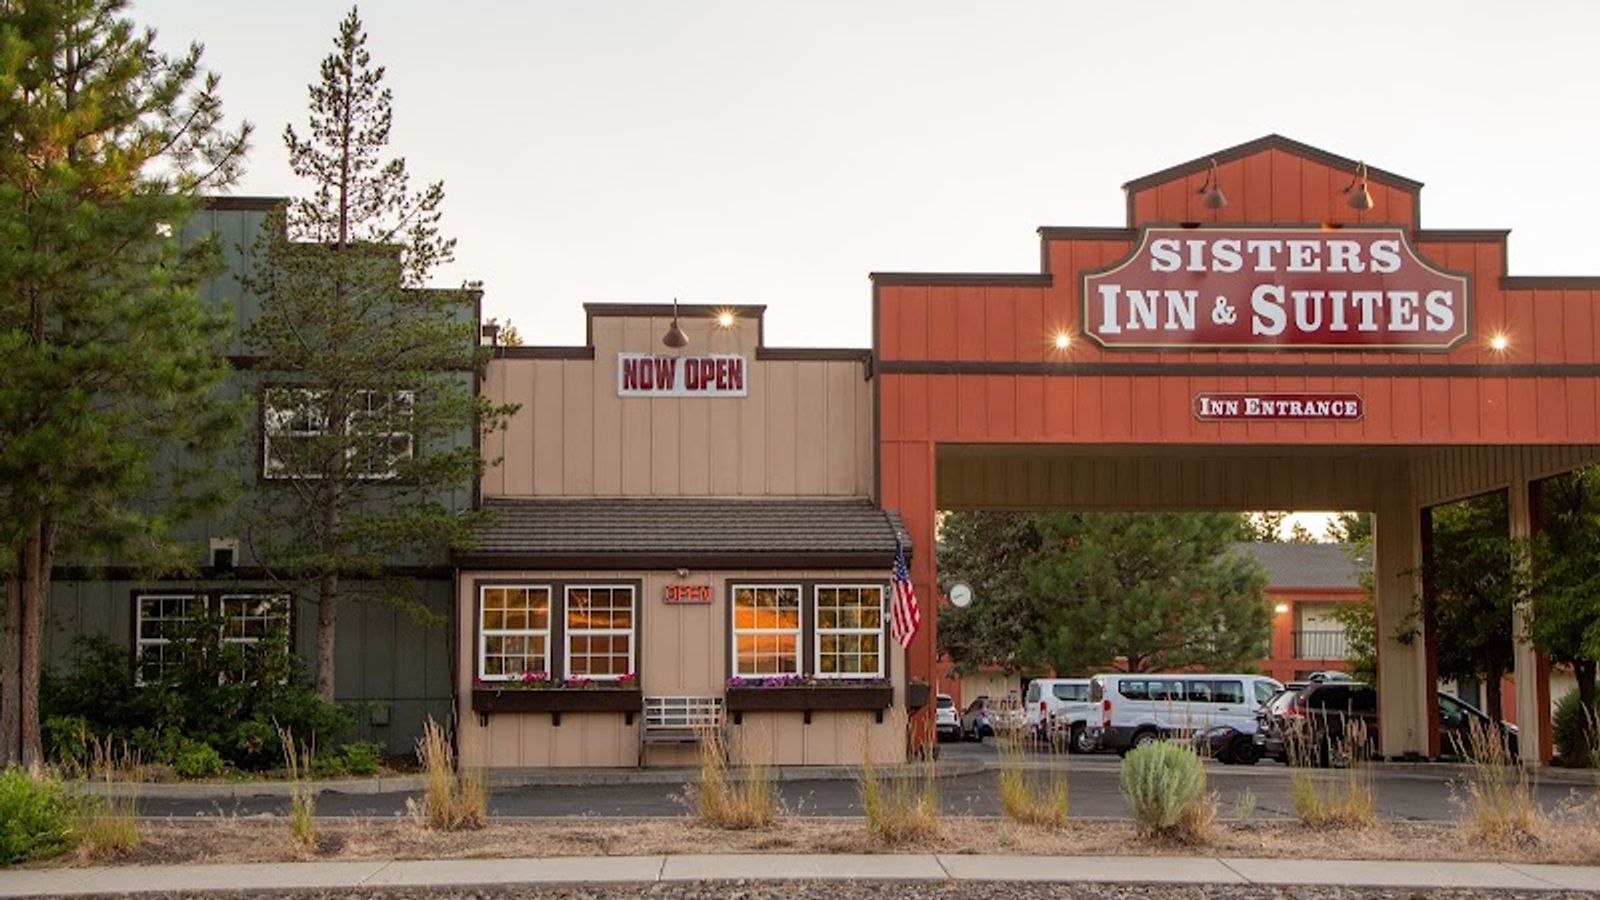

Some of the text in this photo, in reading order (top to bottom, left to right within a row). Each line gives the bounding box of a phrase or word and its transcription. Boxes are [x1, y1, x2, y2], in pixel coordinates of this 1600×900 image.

[1150, 239, 1401, 273] SISTERS
[1098, 284, 1454, 336] INN & SUITES
[623, 358, 743, 390] NOW OPEN
[1200, 398, 1357, 416] INN ENTRANCE
